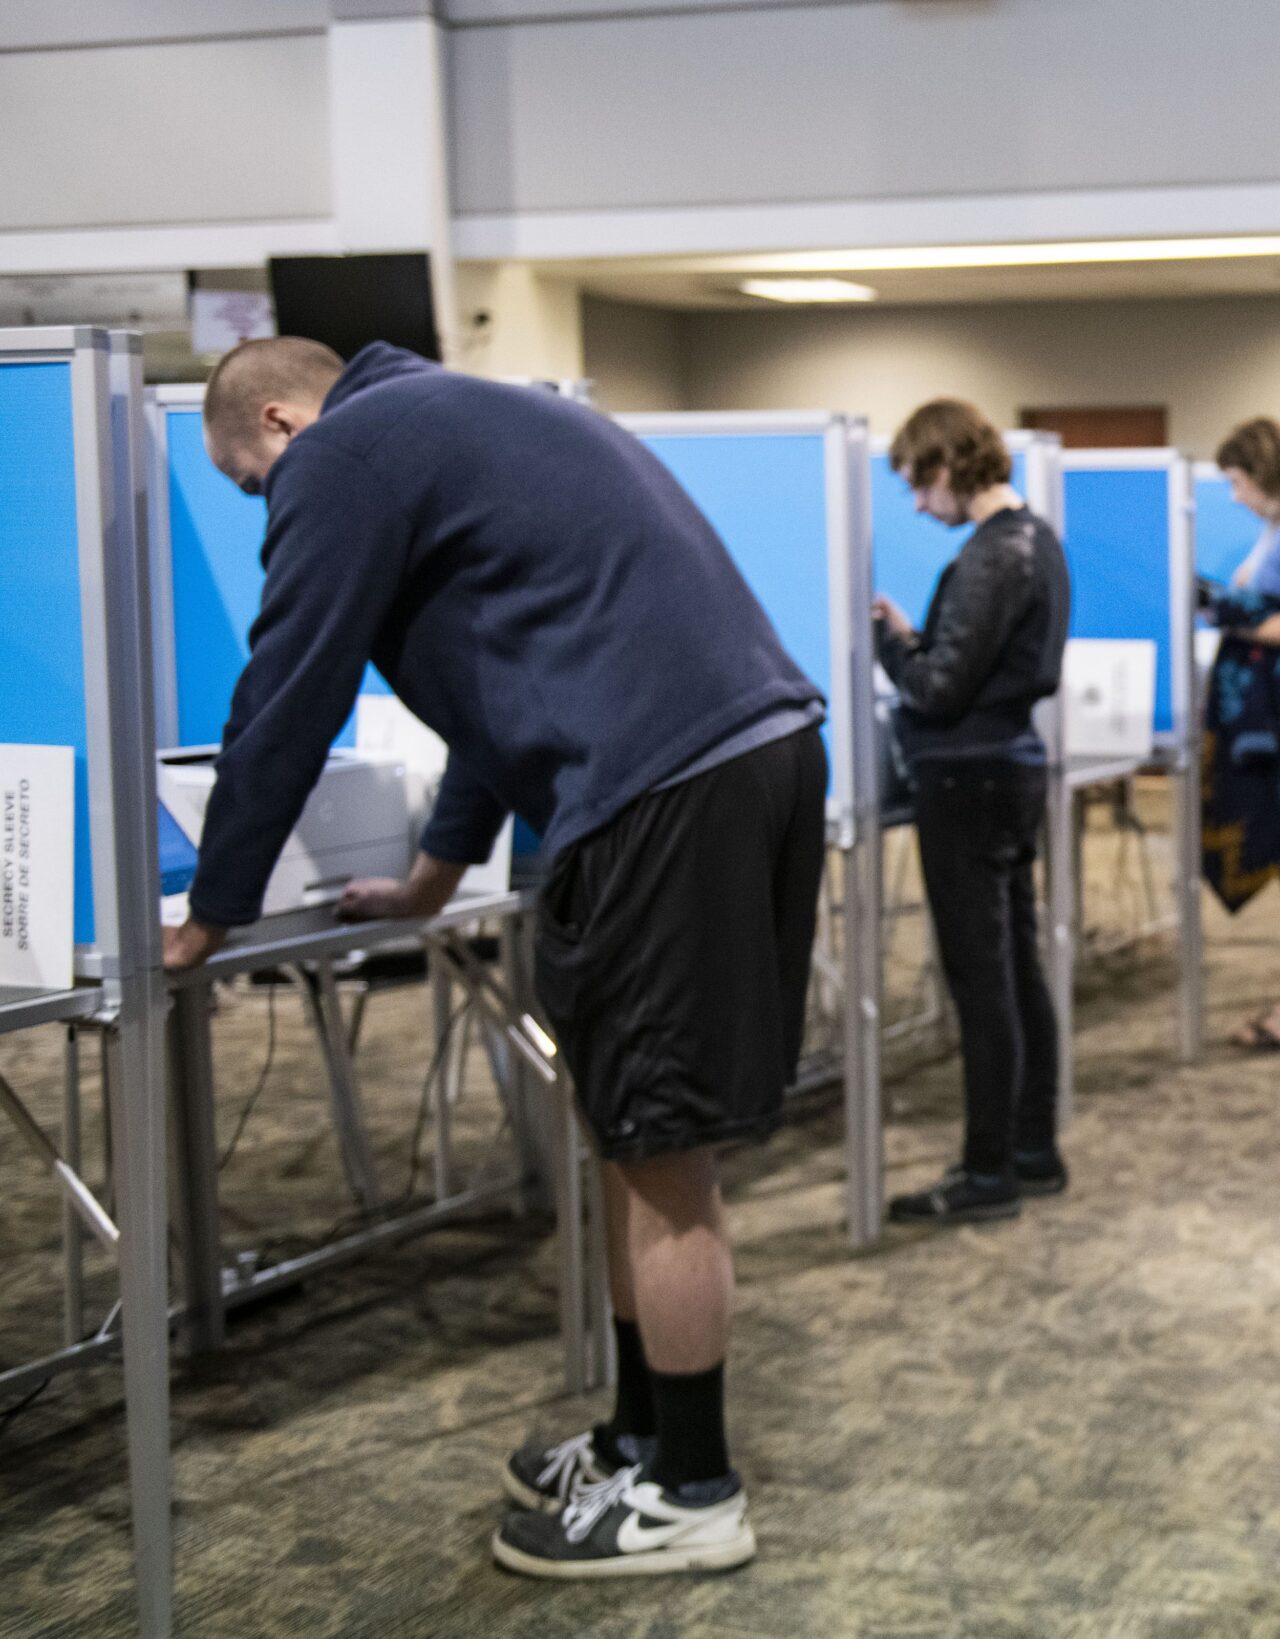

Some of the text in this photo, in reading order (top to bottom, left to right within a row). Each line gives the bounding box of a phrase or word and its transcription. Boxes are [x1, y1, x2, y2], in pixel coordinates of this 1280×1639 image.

[3, 791, 15, 937] SECRECY SLEEVE
[18, 779, 30, 950] SOBRE DE SECRETO
